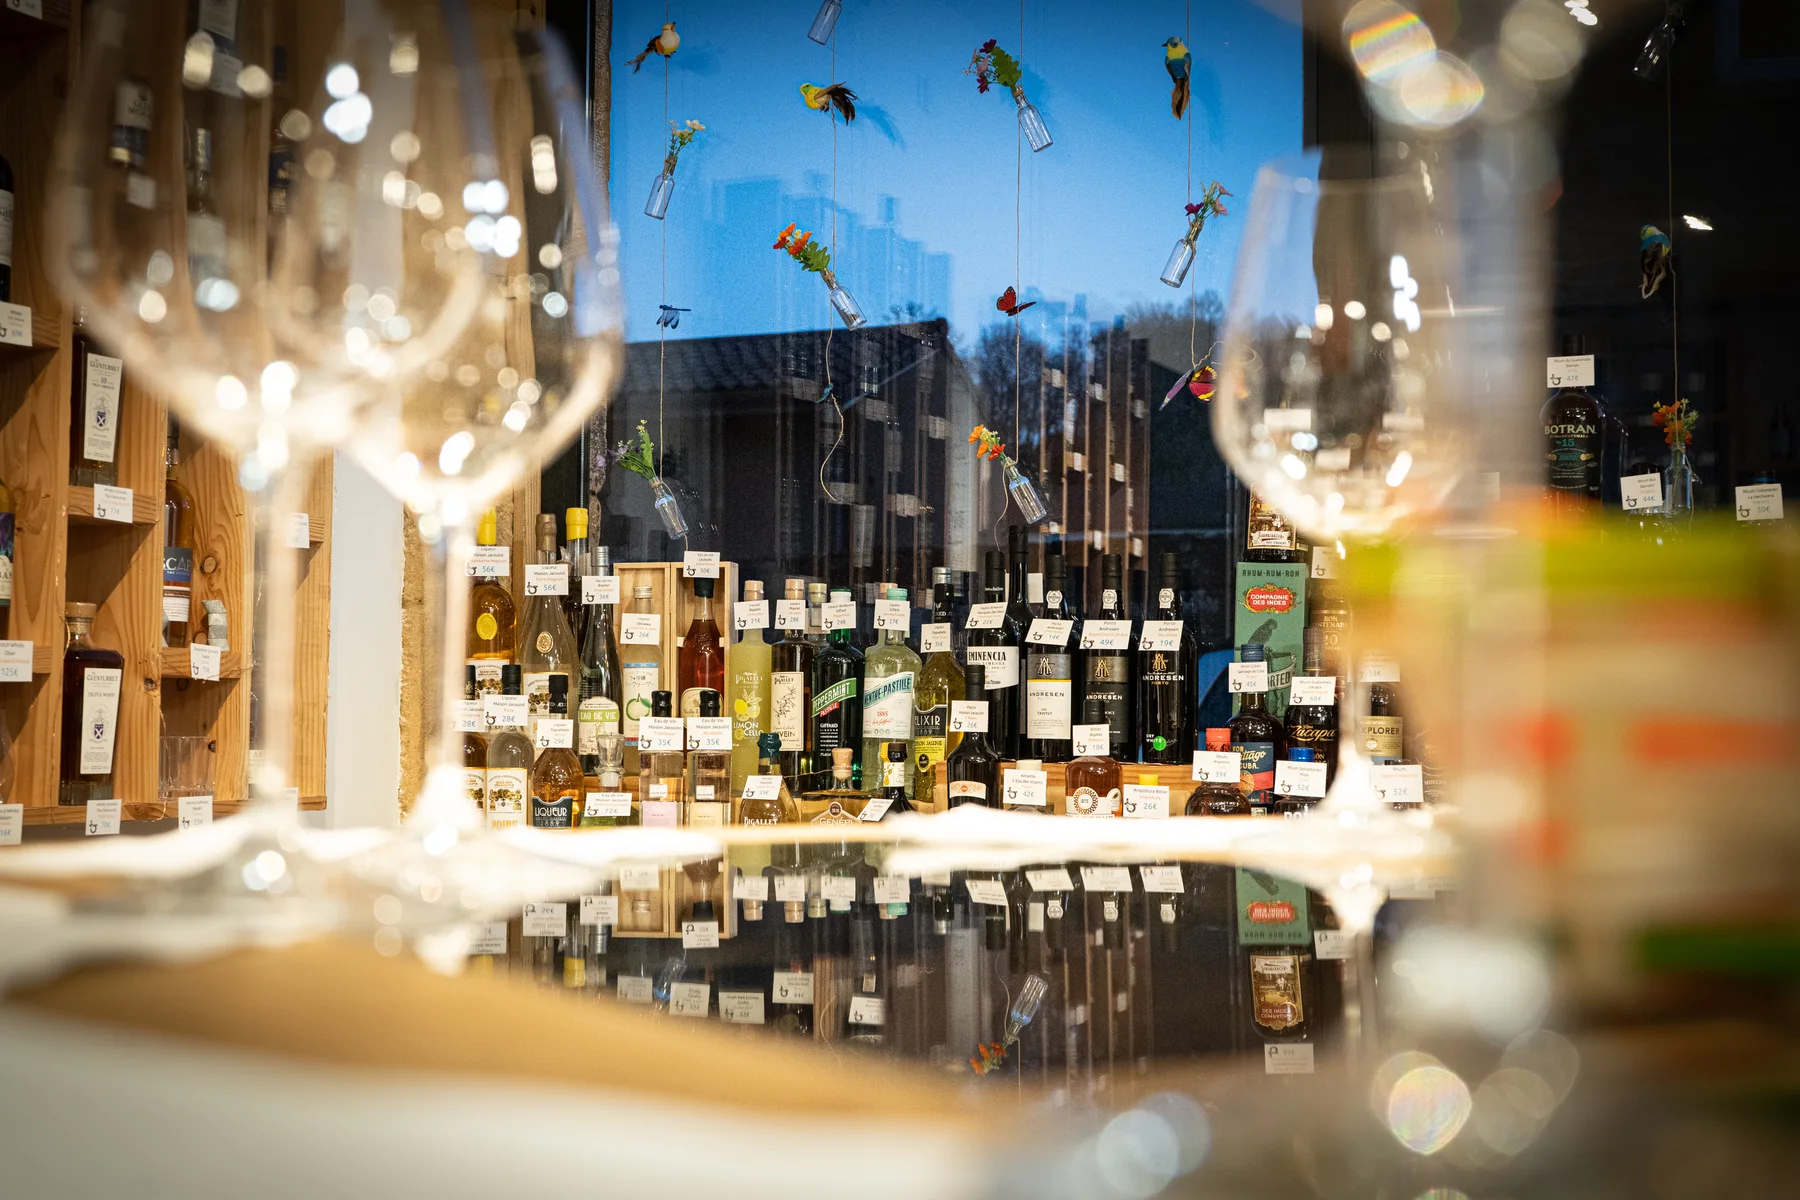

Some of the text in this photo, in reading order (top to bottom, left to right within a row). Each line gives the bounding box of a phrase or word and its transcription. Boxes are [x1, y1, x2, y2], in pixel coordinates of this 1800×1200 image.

[1544, 424, 1596, 435] BOTRAN
[1561, 438, 1575, 448] 15
[1242, 569, 1300, 577] RHUM-RUM-RON
[968, 651, 1007, 661] EMINENCIA
[86, 674, 118, 683] GLENTURRET
[812, 682, 851, 712] PEPPERMINT
[580, 711, 616, 720] EAU DE VIE
[733, 721, 759, 730] LIMON
[914, 715, 941, 727] ELIXIR
[1290, 725, 1336, 742] Zacapa
[706, 738, 721, 746] 35€
[1092, 743, 1105, 751] 18€
[1296, 784, 1310, 792] 52€
[1393, 788, 1408, 796] 52€
[534, 806, 568, 817] LIQUEUR
[1143, 803, 1158, 811] 26€
[744, 816, 779, 826] BIGALLET
